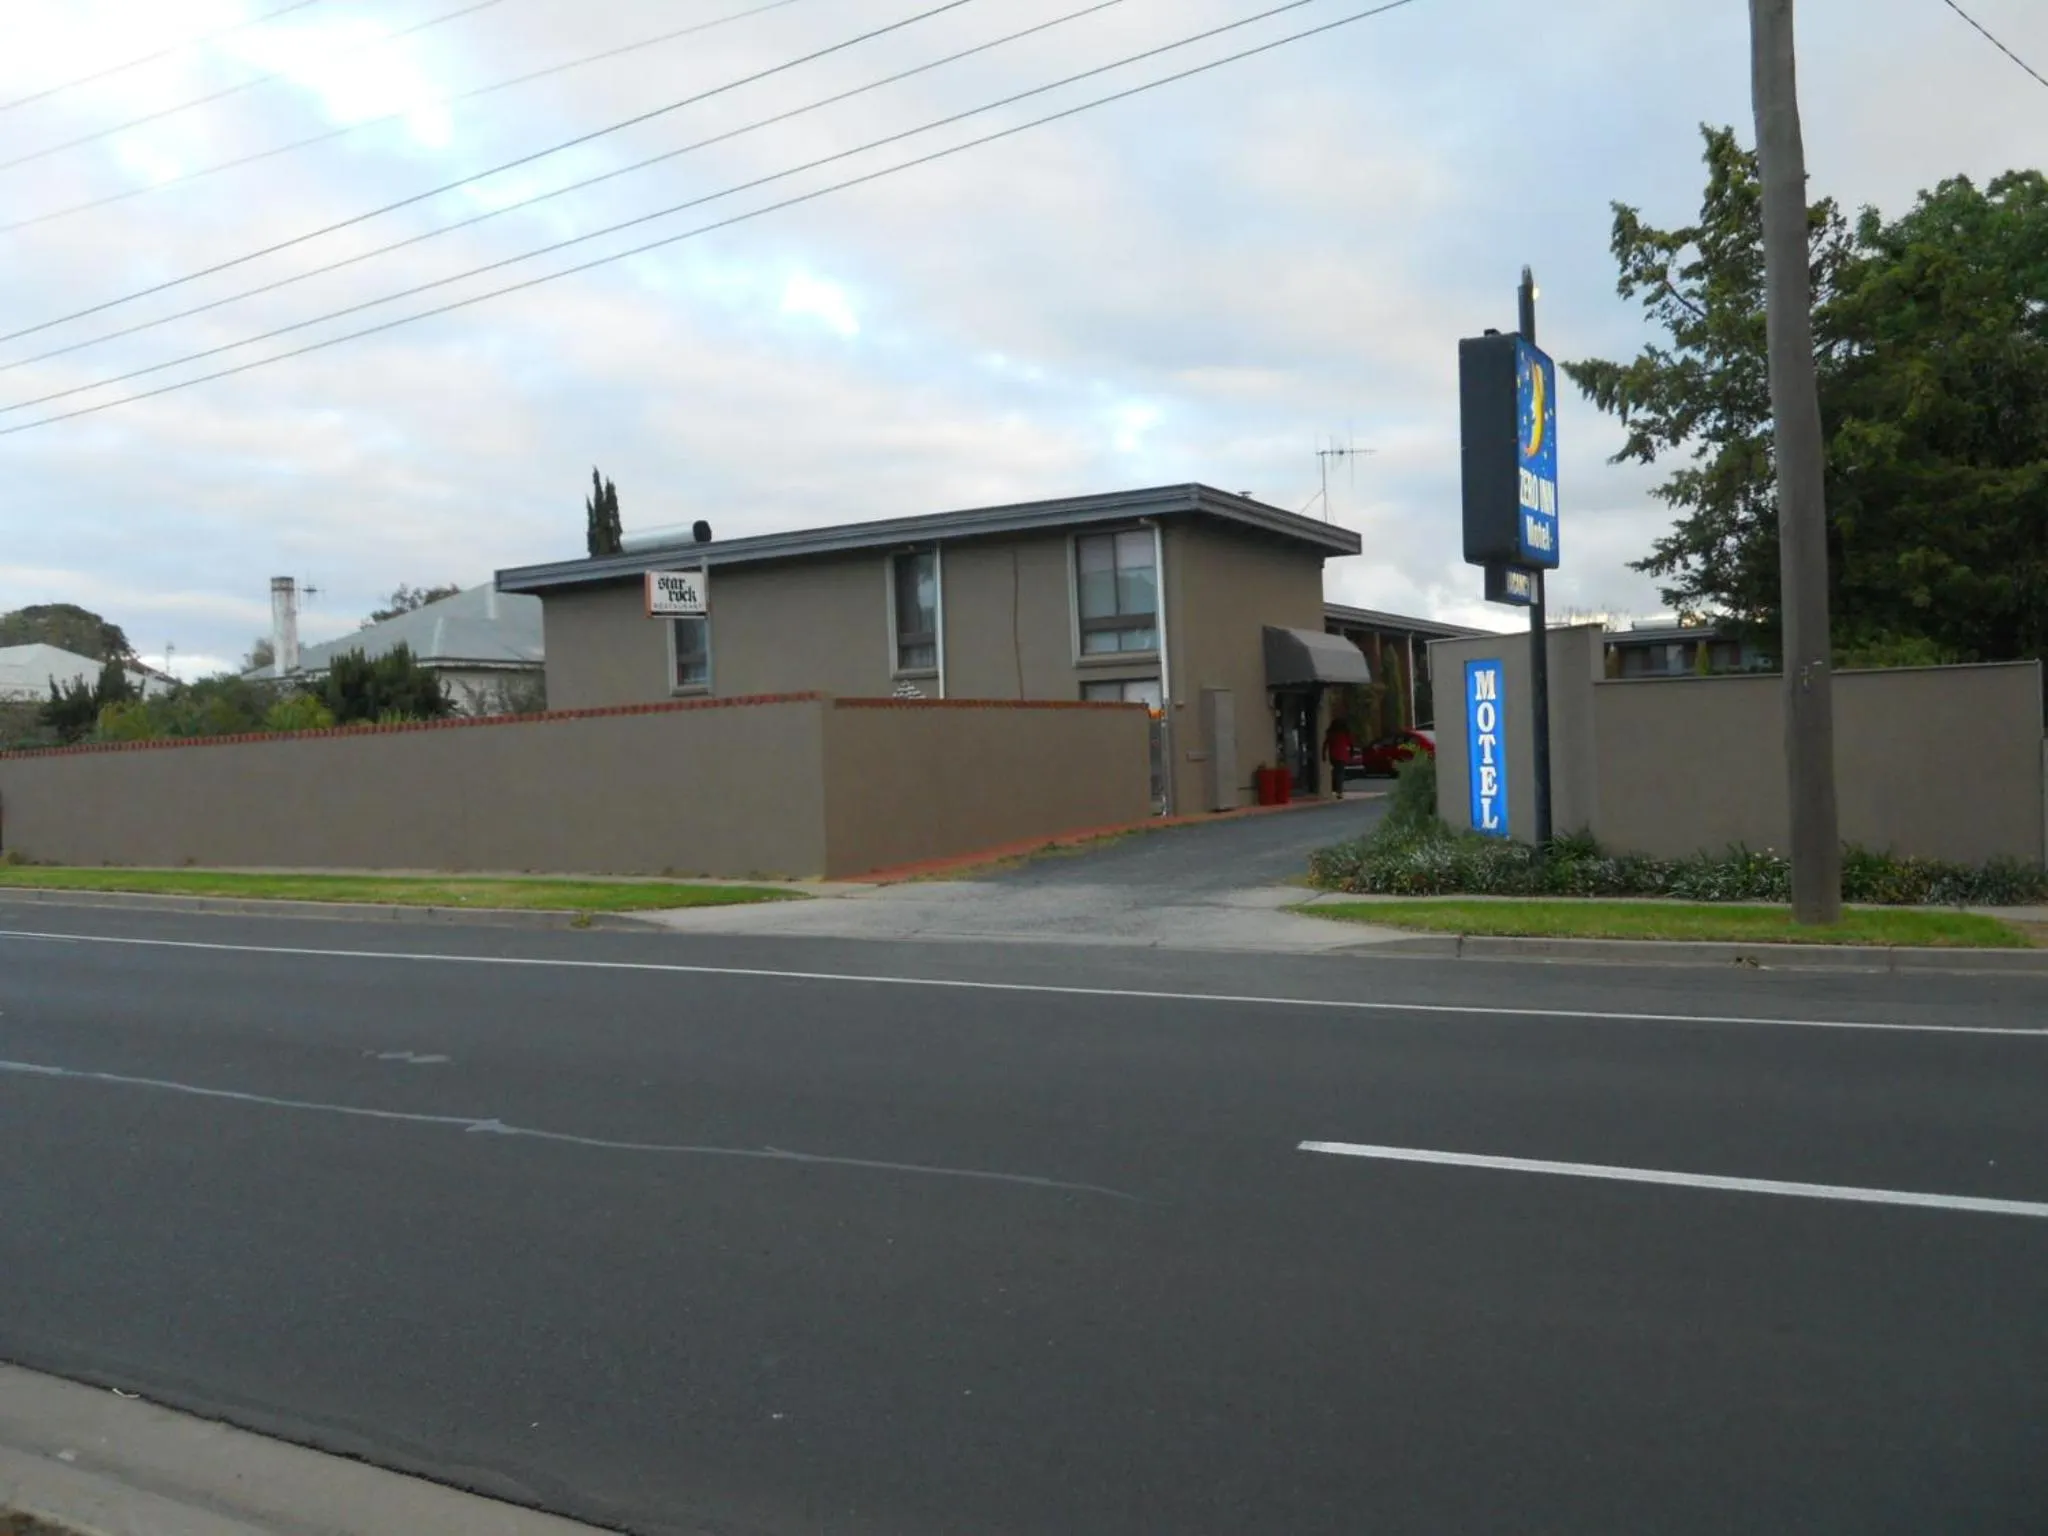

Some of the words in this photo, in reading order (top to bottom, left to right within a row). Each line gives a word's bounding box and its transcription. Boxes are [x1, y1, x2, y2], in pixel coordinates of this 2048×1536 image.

[657, 577, 686, 590] star
[668, 586, 697, 602] rock
[1475, 670, 1498, 829] MOTEL
